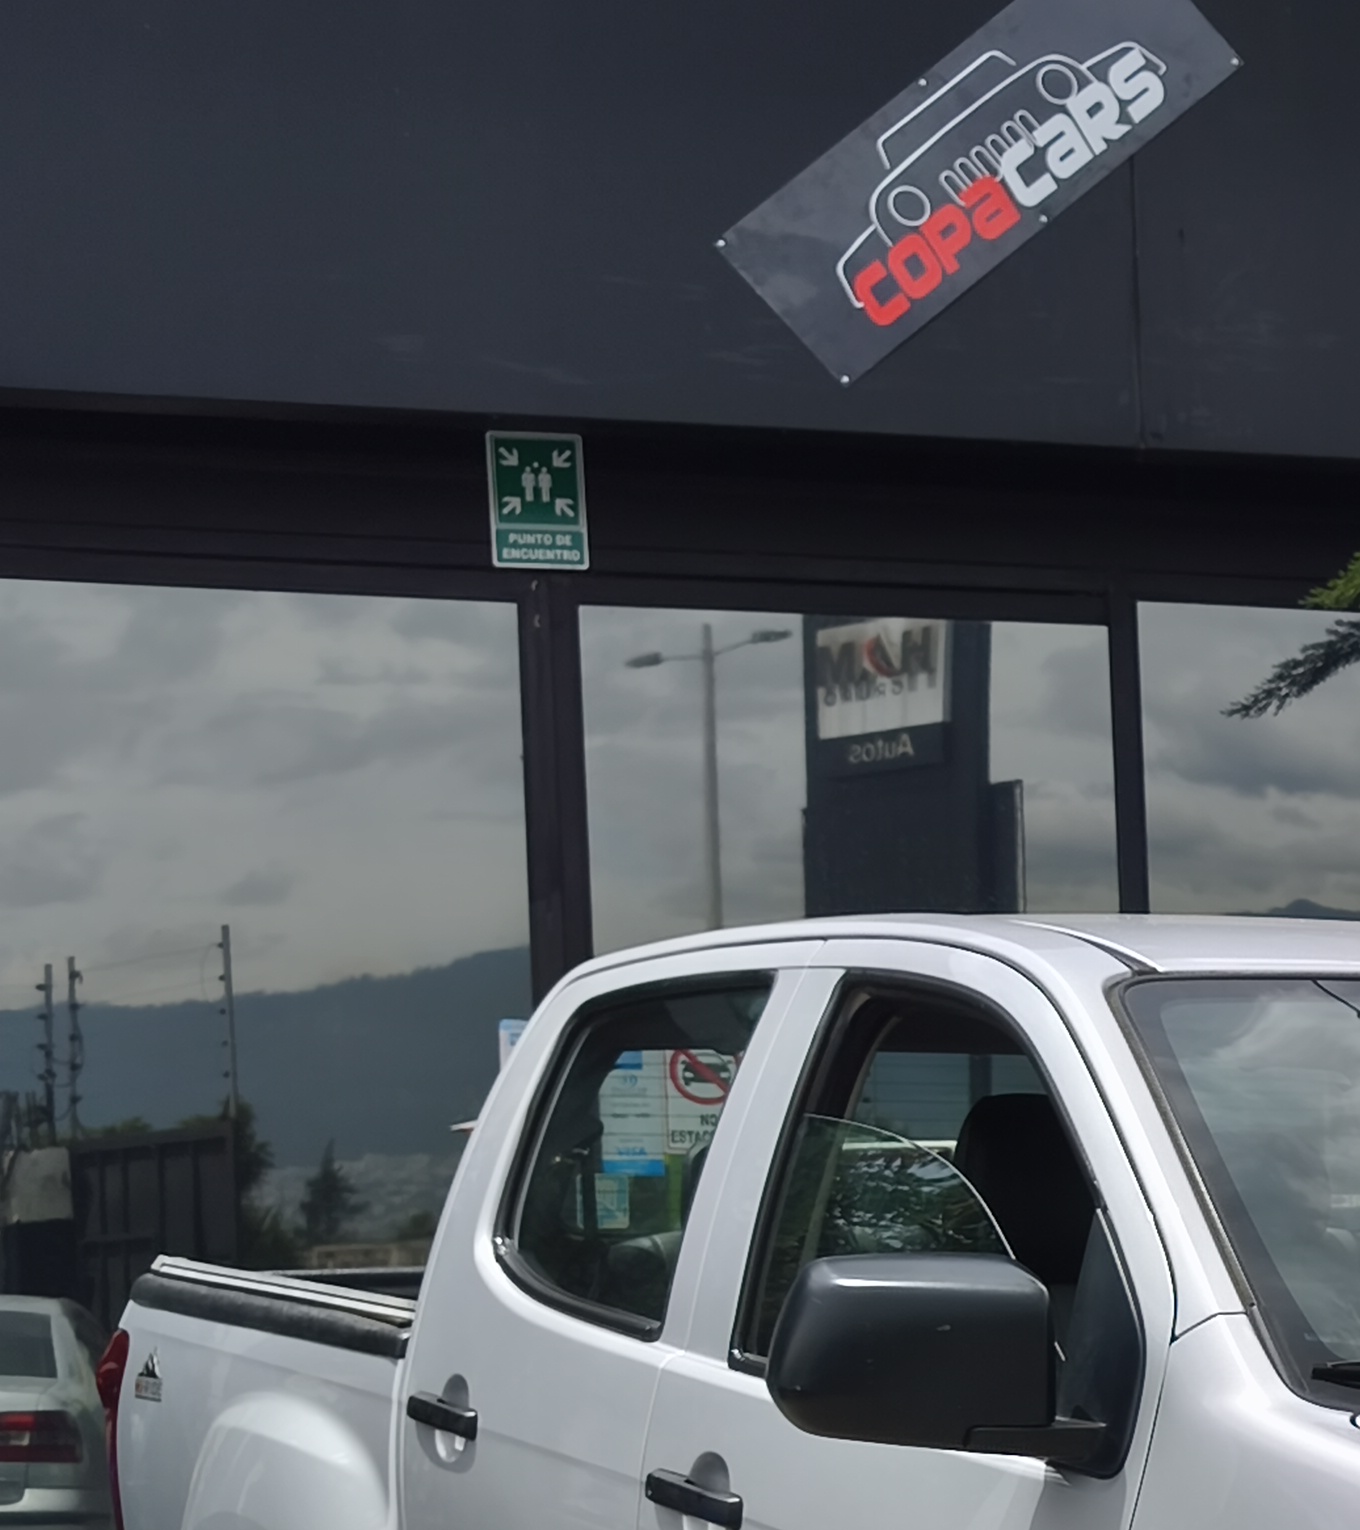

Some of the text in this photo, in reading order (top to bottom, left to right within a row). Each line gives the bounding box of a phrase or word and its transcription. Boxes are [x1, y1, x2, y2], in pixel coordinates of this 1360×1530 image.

[508, 533, 573, 546] PUNTO DE
[501, 547, 581, 562] ENCUENTRO
